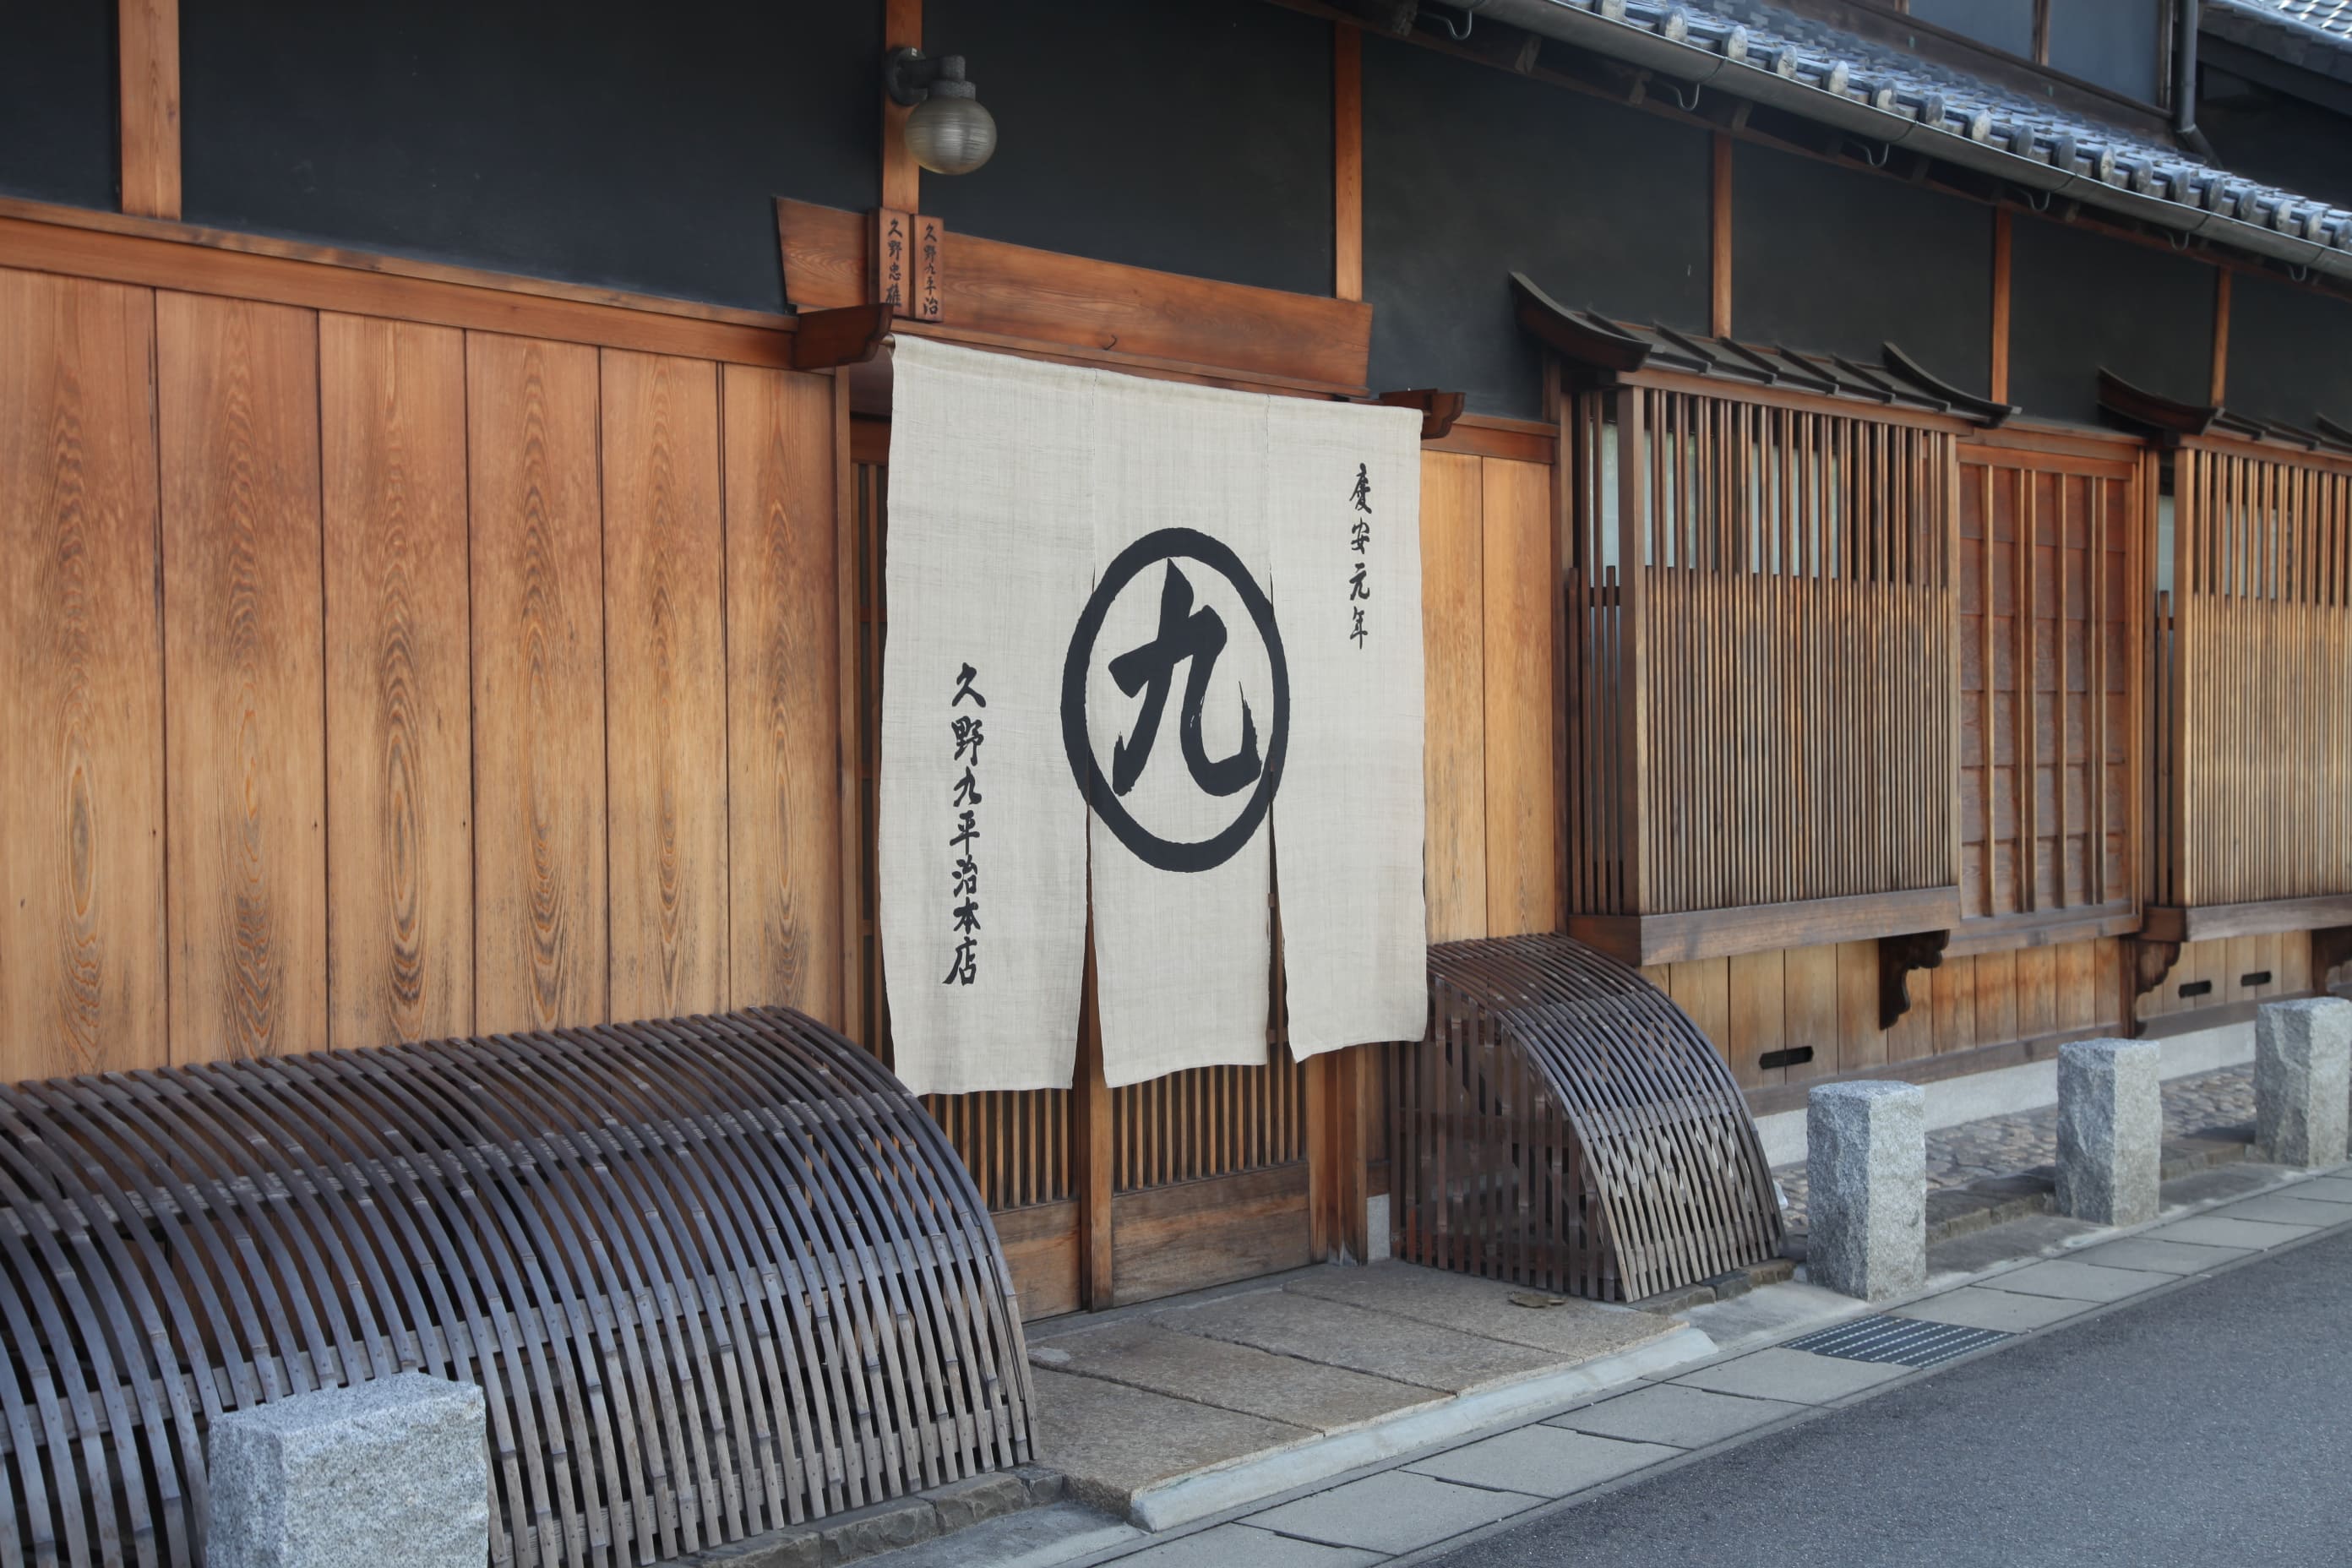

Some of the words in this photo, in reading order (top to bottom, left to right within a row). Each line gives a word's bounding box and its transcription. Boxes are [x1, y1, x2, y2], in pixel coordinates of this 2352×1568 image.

[923, 223, 939, 316] 久野九平治
[1349, 462, 1372, 650] 慶安元年
[942, 662, 987, 987] 久野九平治本店
